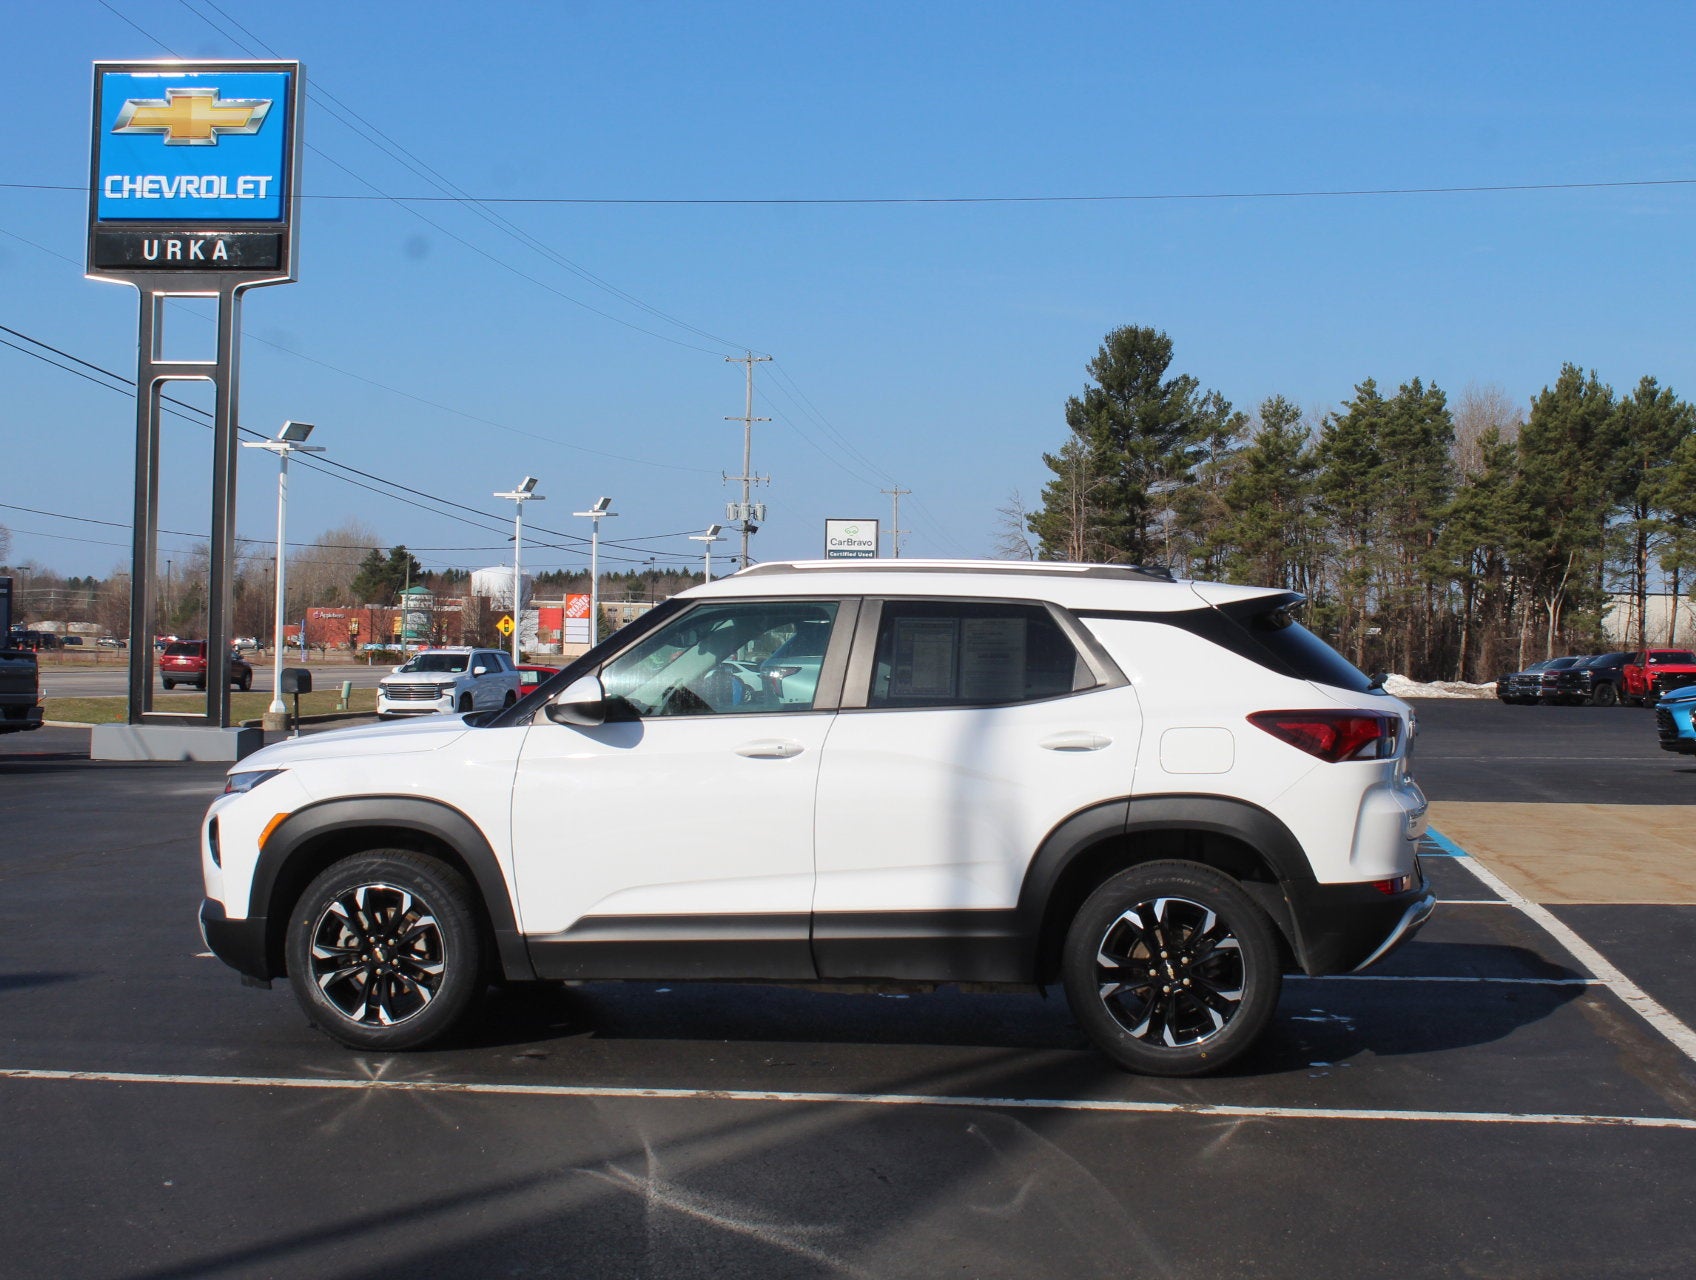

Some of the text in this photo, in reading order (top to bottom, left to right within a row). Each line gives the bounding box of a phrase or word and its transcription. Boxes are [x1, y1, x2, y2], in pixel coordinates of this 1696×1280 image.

[104, 175, 273, 199] CHEVROLET
[143, 239, 228, 260] URKA
[830, 537, 873, 547] CarBravo
